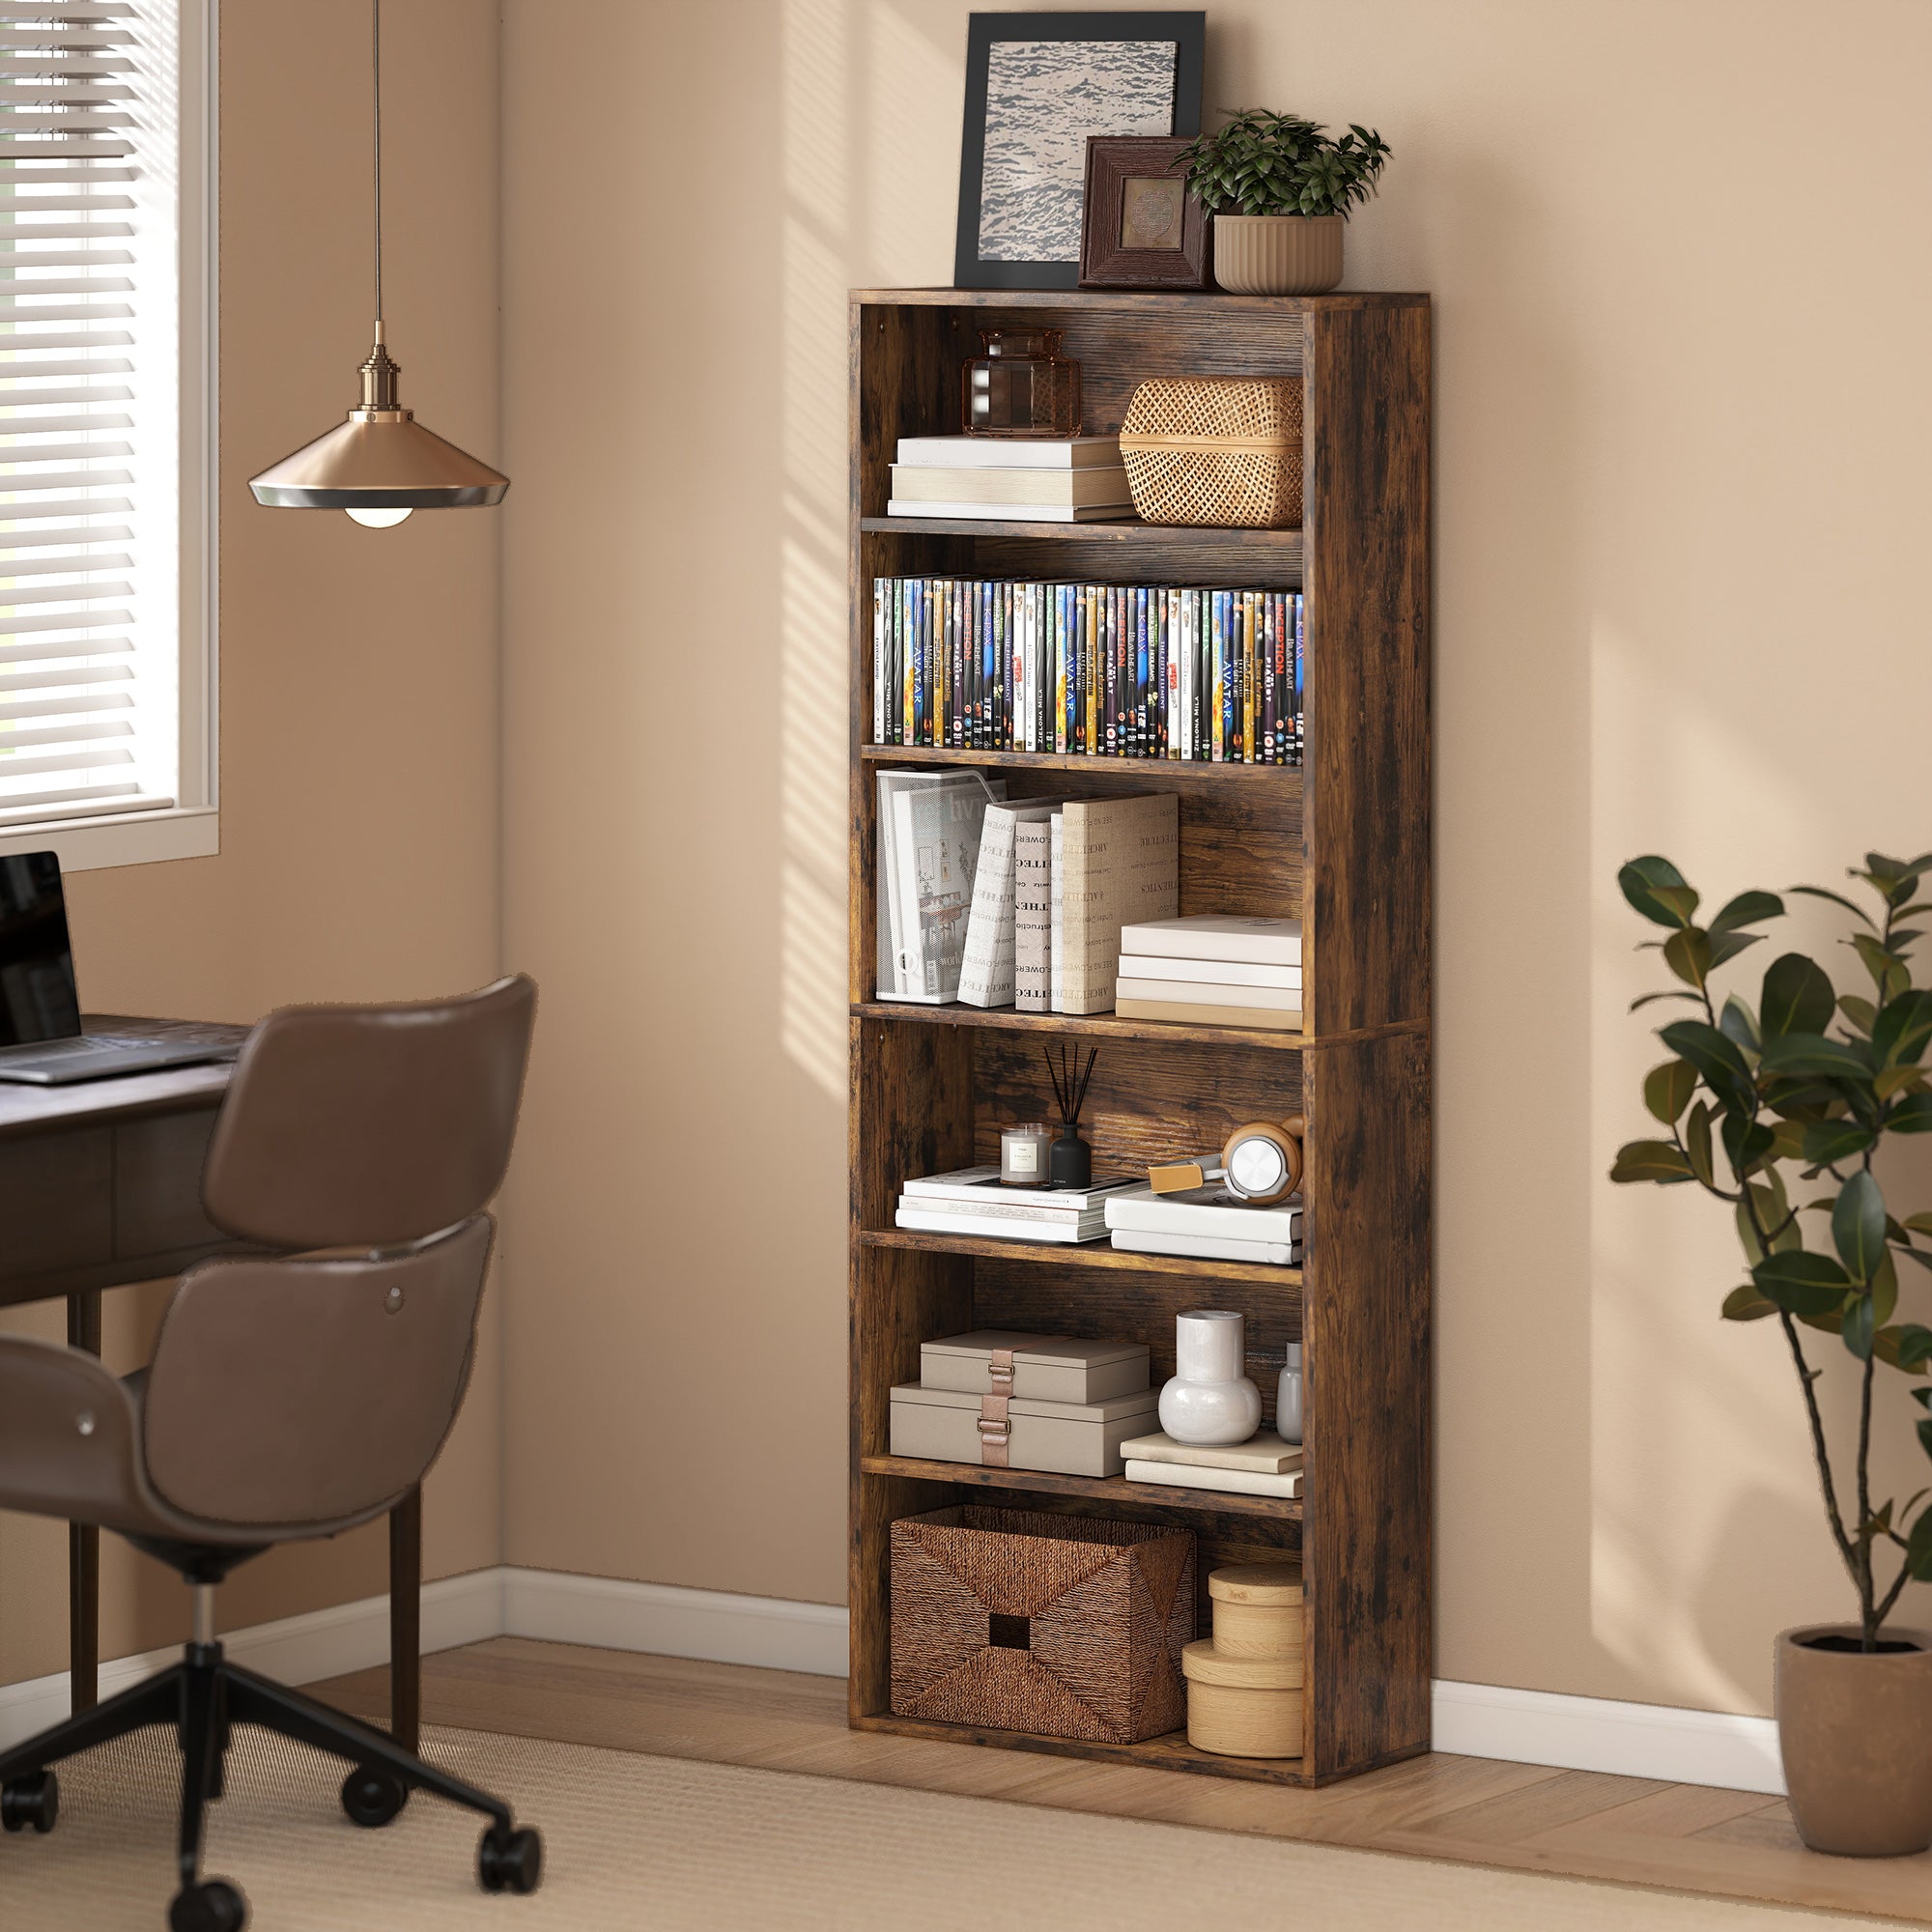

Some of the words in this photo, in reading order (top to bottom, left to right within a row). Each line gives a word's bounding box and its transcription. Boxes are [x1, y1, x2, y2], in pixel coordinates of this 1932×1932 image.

[963, 591, 973, 660] INCEPTION
[983, 609, 992, 645] K-PAX
[1117, 597, 1126, 668] INCEPTION
[1137, 614, 1147, 652] K-PAX
[1275, 604, 1284, 674] INCEPTION
[913, 647, 923, 703] AVATAR
[1065, 654, 1074, 711] AVATAR
[1223, 660, 1232, 719] AVATAR
[1286, 638, 1294, 690] BRAVEHEART
